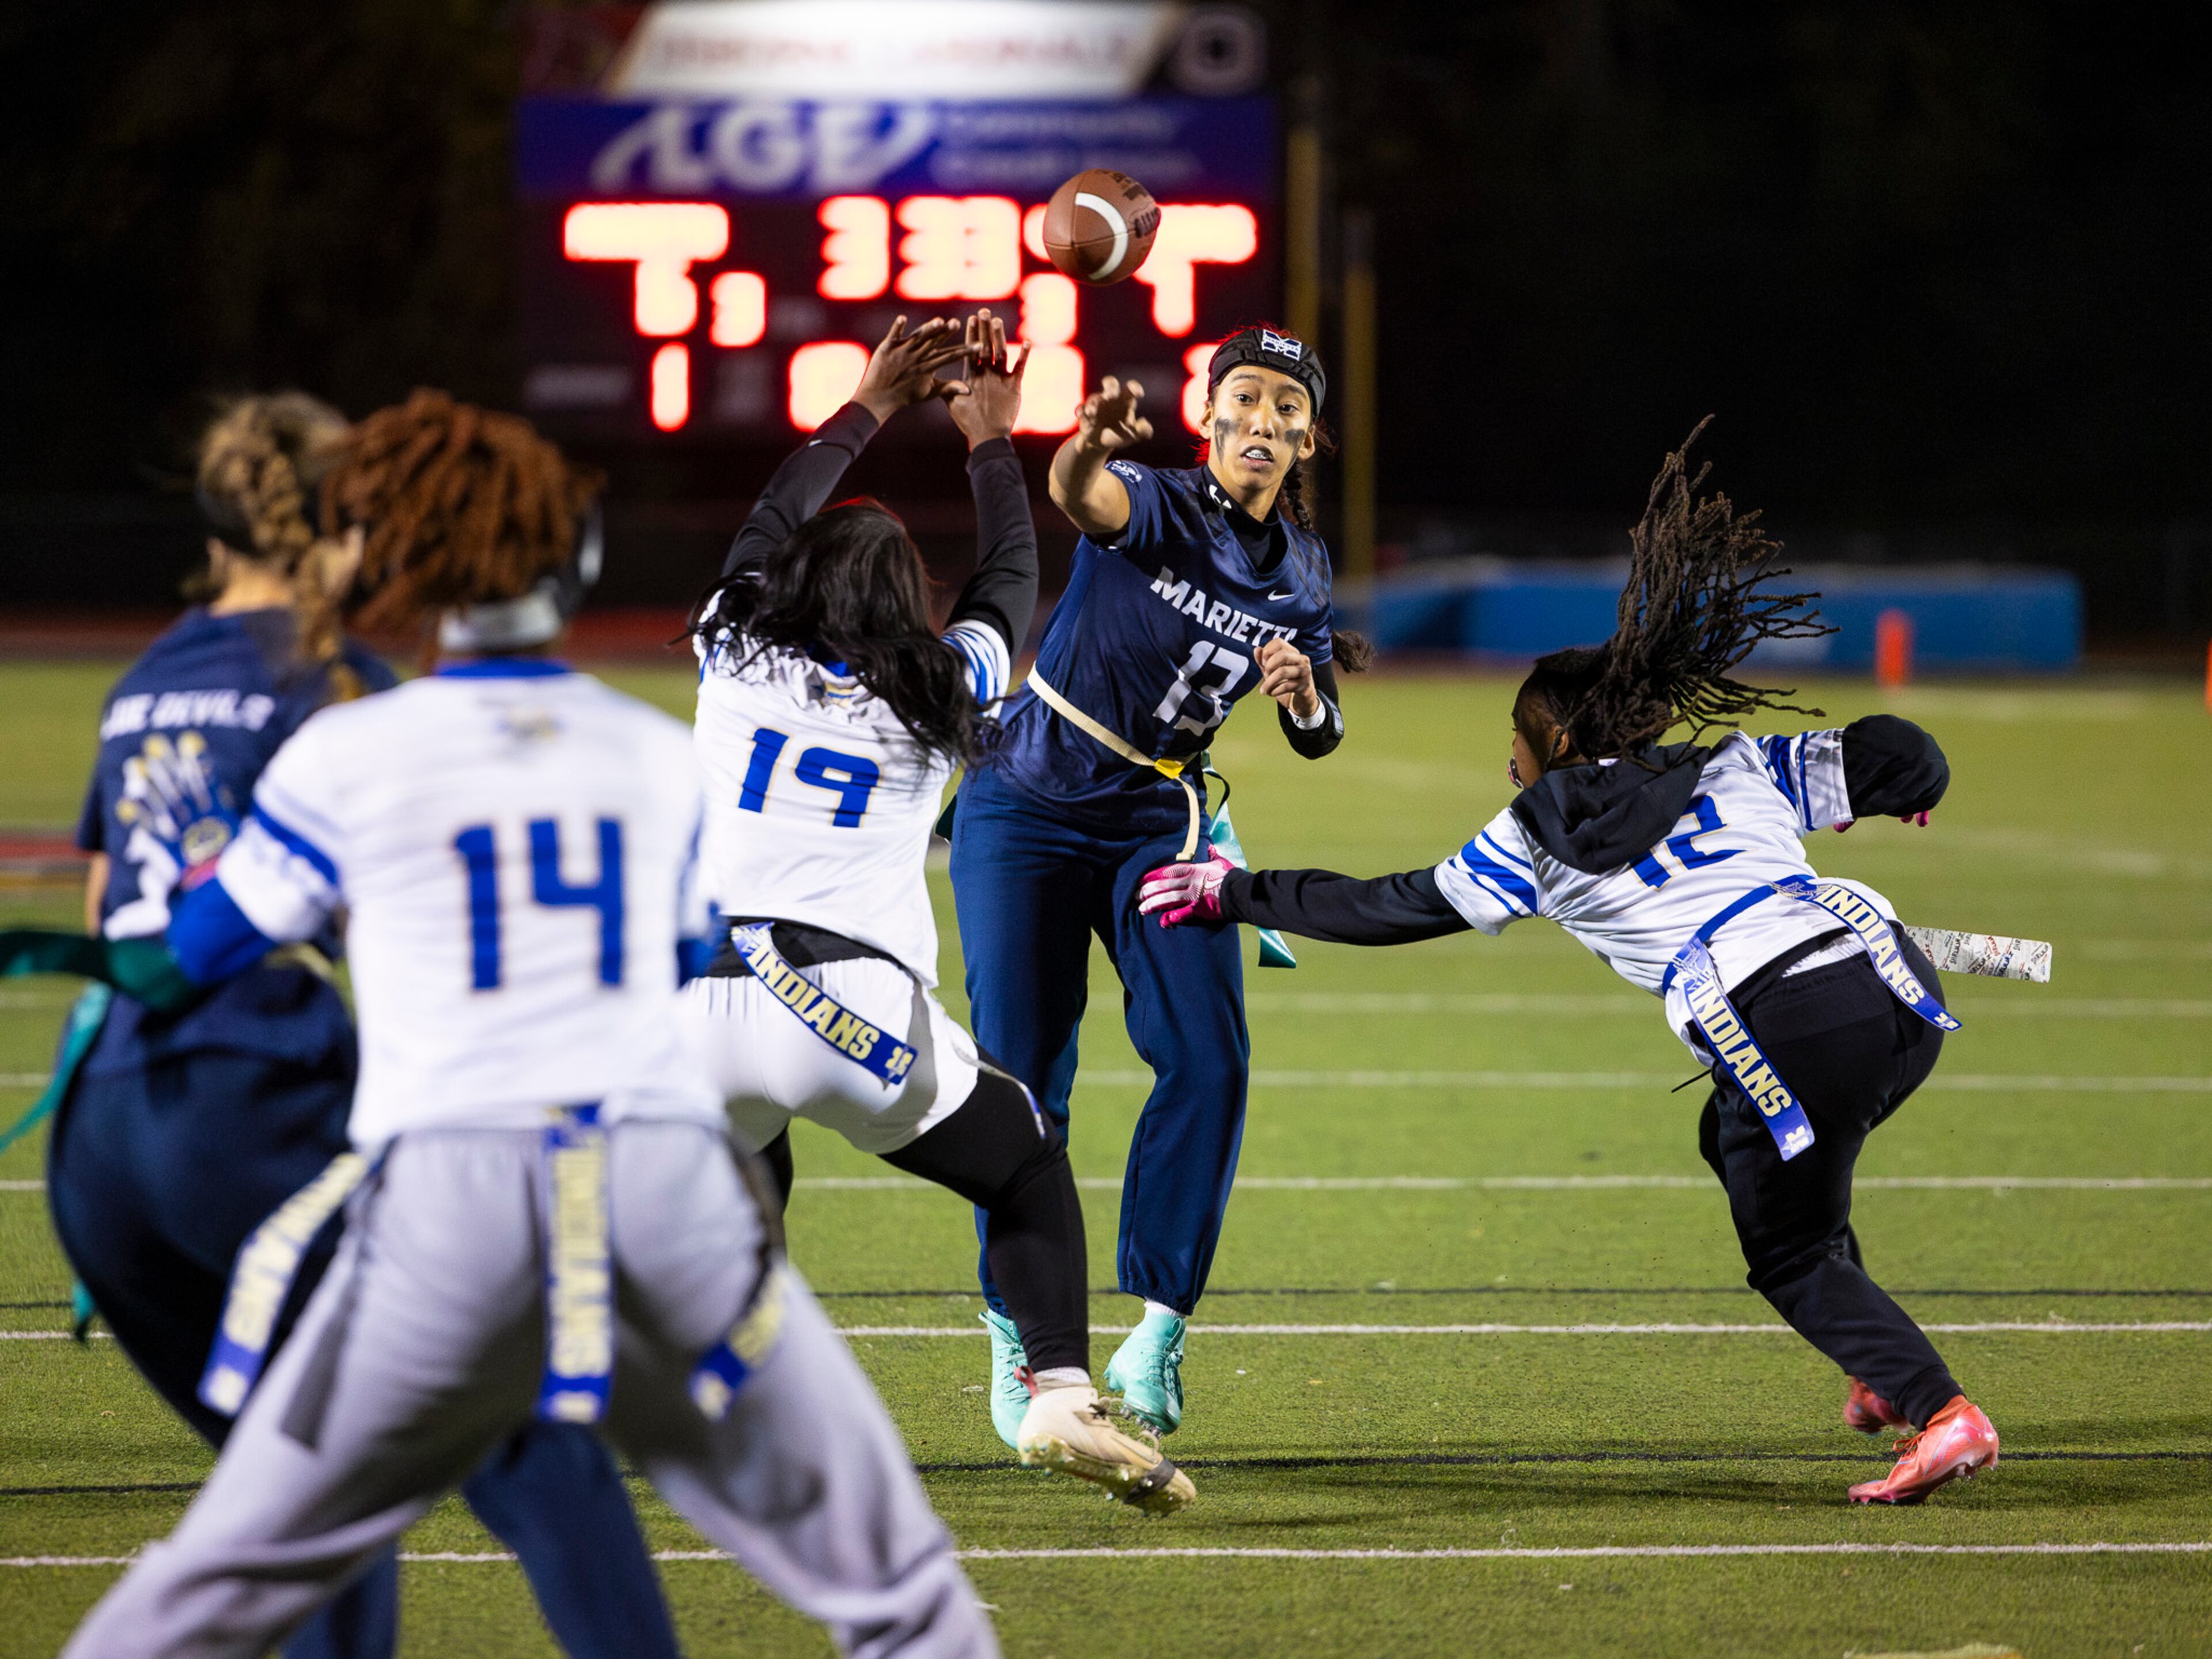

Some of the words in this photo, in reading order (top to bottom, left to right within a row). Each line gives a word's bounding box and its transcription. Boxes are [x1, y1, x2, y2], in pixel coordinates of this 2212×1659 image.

[1153, 640, 1249, 736] 13
[738, 727, 880, 828] 19
[452, 816, 623, 990] 14
[1813, 885, 1925, 1005] INDIANS
[746, 942, 880, 1060] INDIANS
[1688, 980, 1792, 1118] INDIANS
